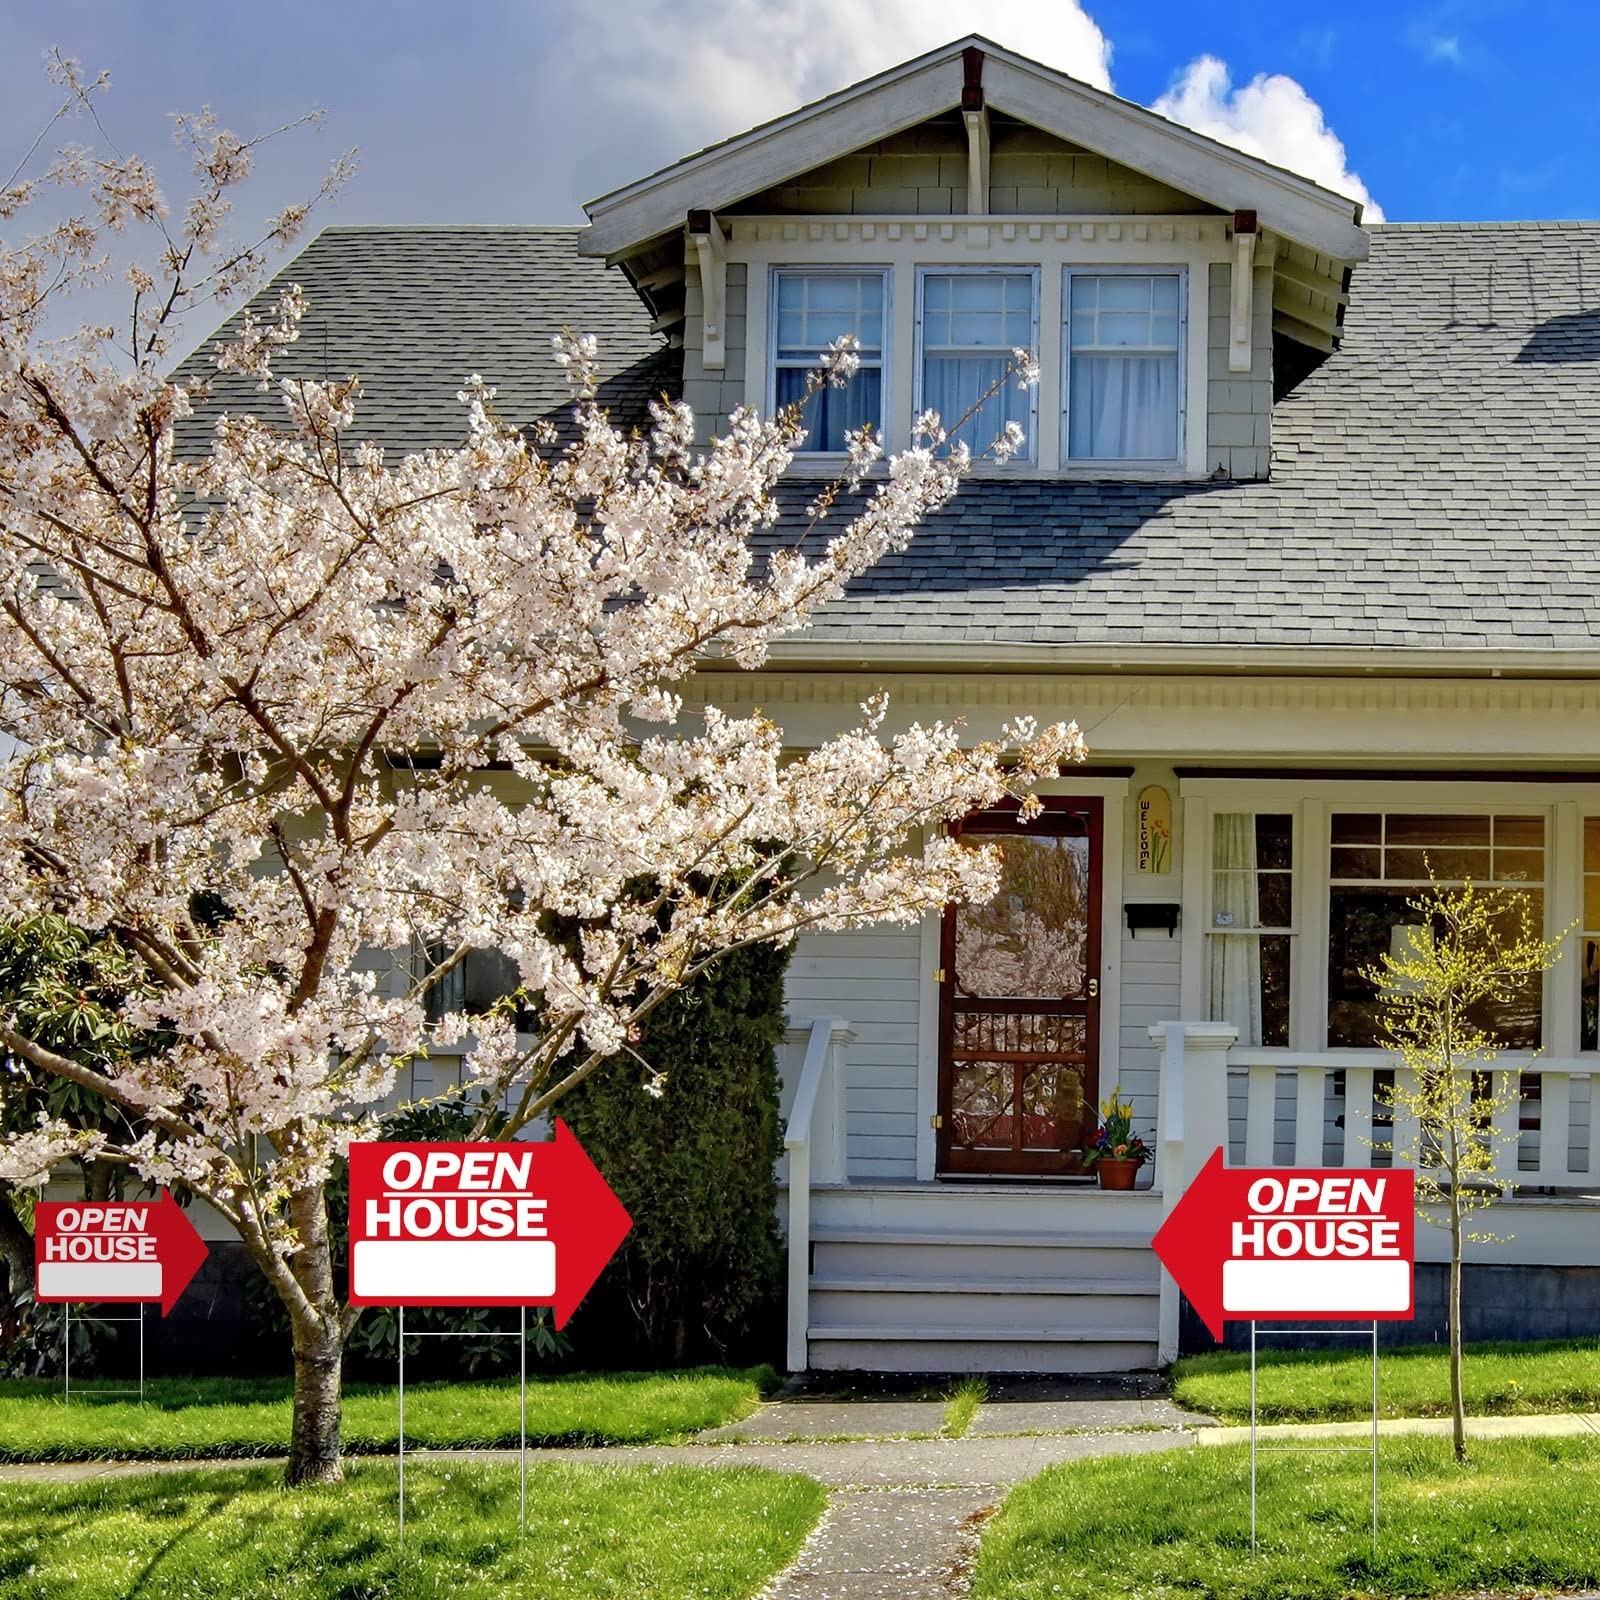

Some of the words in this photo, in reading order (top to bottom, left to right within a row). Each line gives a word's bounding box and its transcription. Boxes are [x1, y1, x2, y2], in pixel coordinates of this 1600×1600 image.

[1140, 801, 1150, 869] WELCOME
[383, 1152, 533, 1190] OPEN
[1247, 1178, 1386, 1213] OPEN
[56, 1208, 148, 1231] OPEN
[365, 1199, 548, 1237] HOUSE
[46, 1237, 157, 1260] HOUSE
[1232, 1221, 1400, 1256] HOUSE
